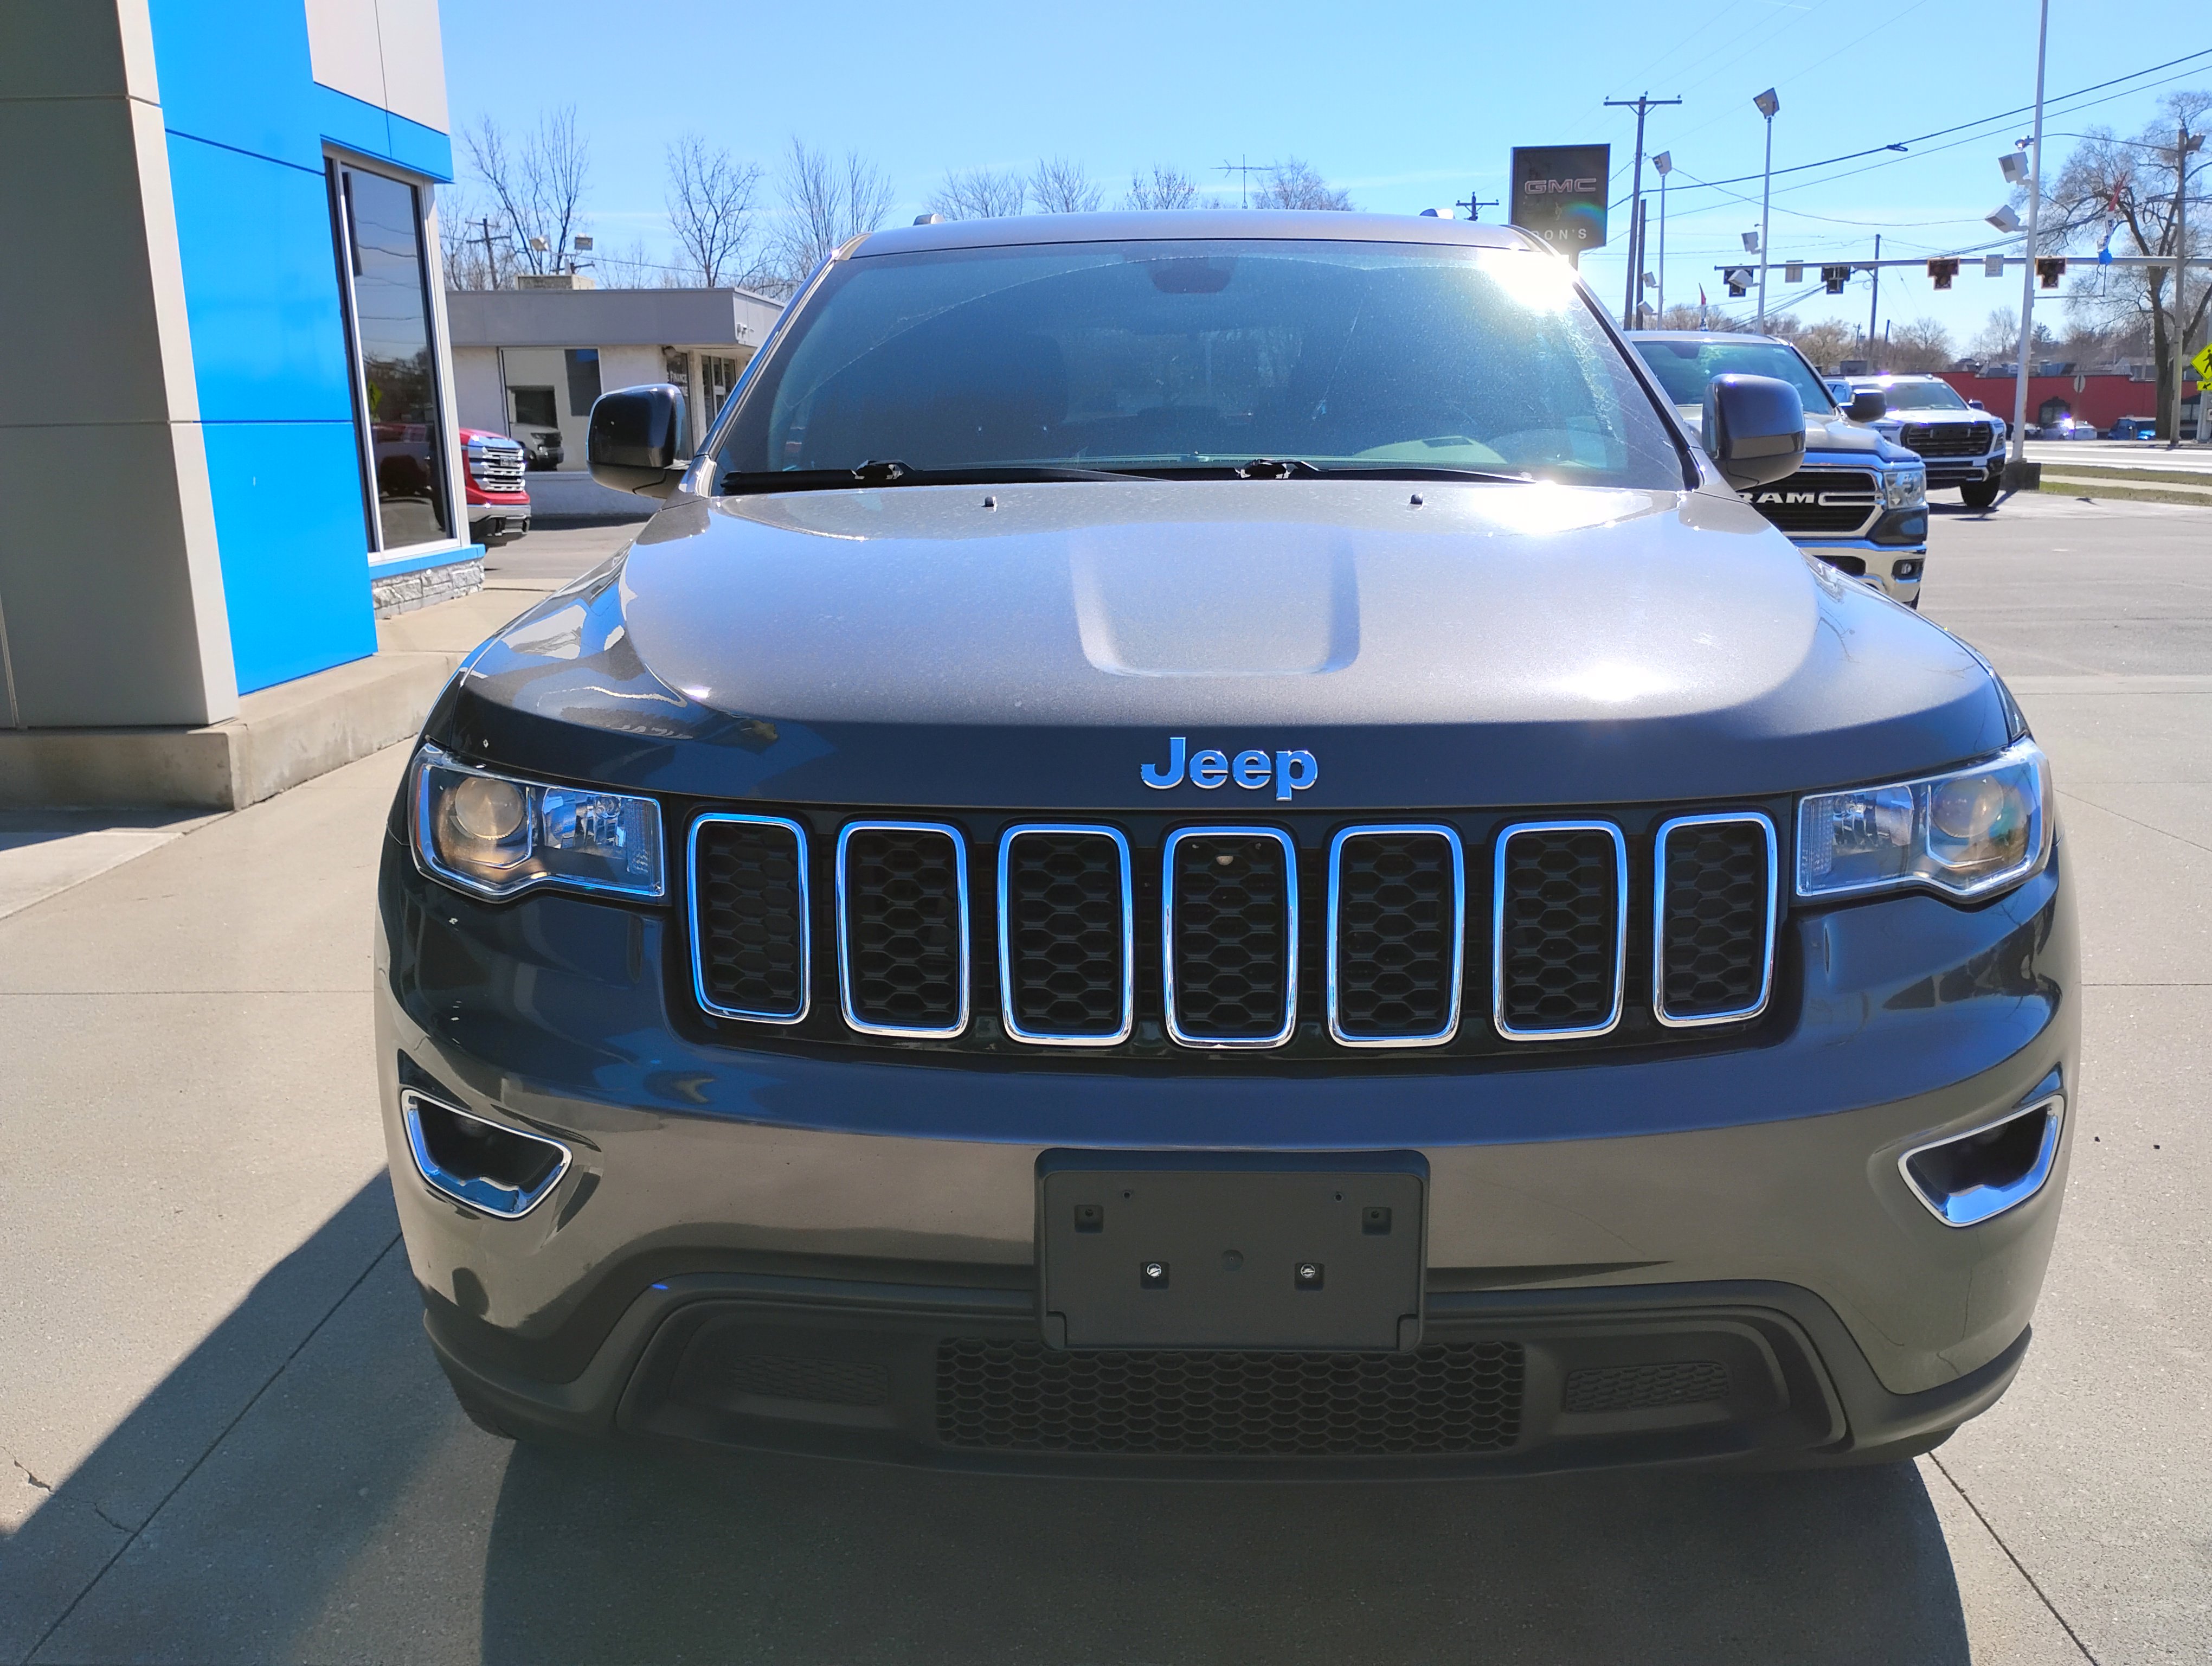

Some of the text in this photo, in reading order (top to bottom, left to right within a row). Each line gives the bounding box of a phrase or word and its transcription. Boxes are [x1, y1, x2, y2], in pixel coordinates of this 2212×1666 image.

[1525, 178, 1597, 194] GMC
[1737, 492, 1815, 503] RAM
[1140, 736, 1318, 801] Jeep
